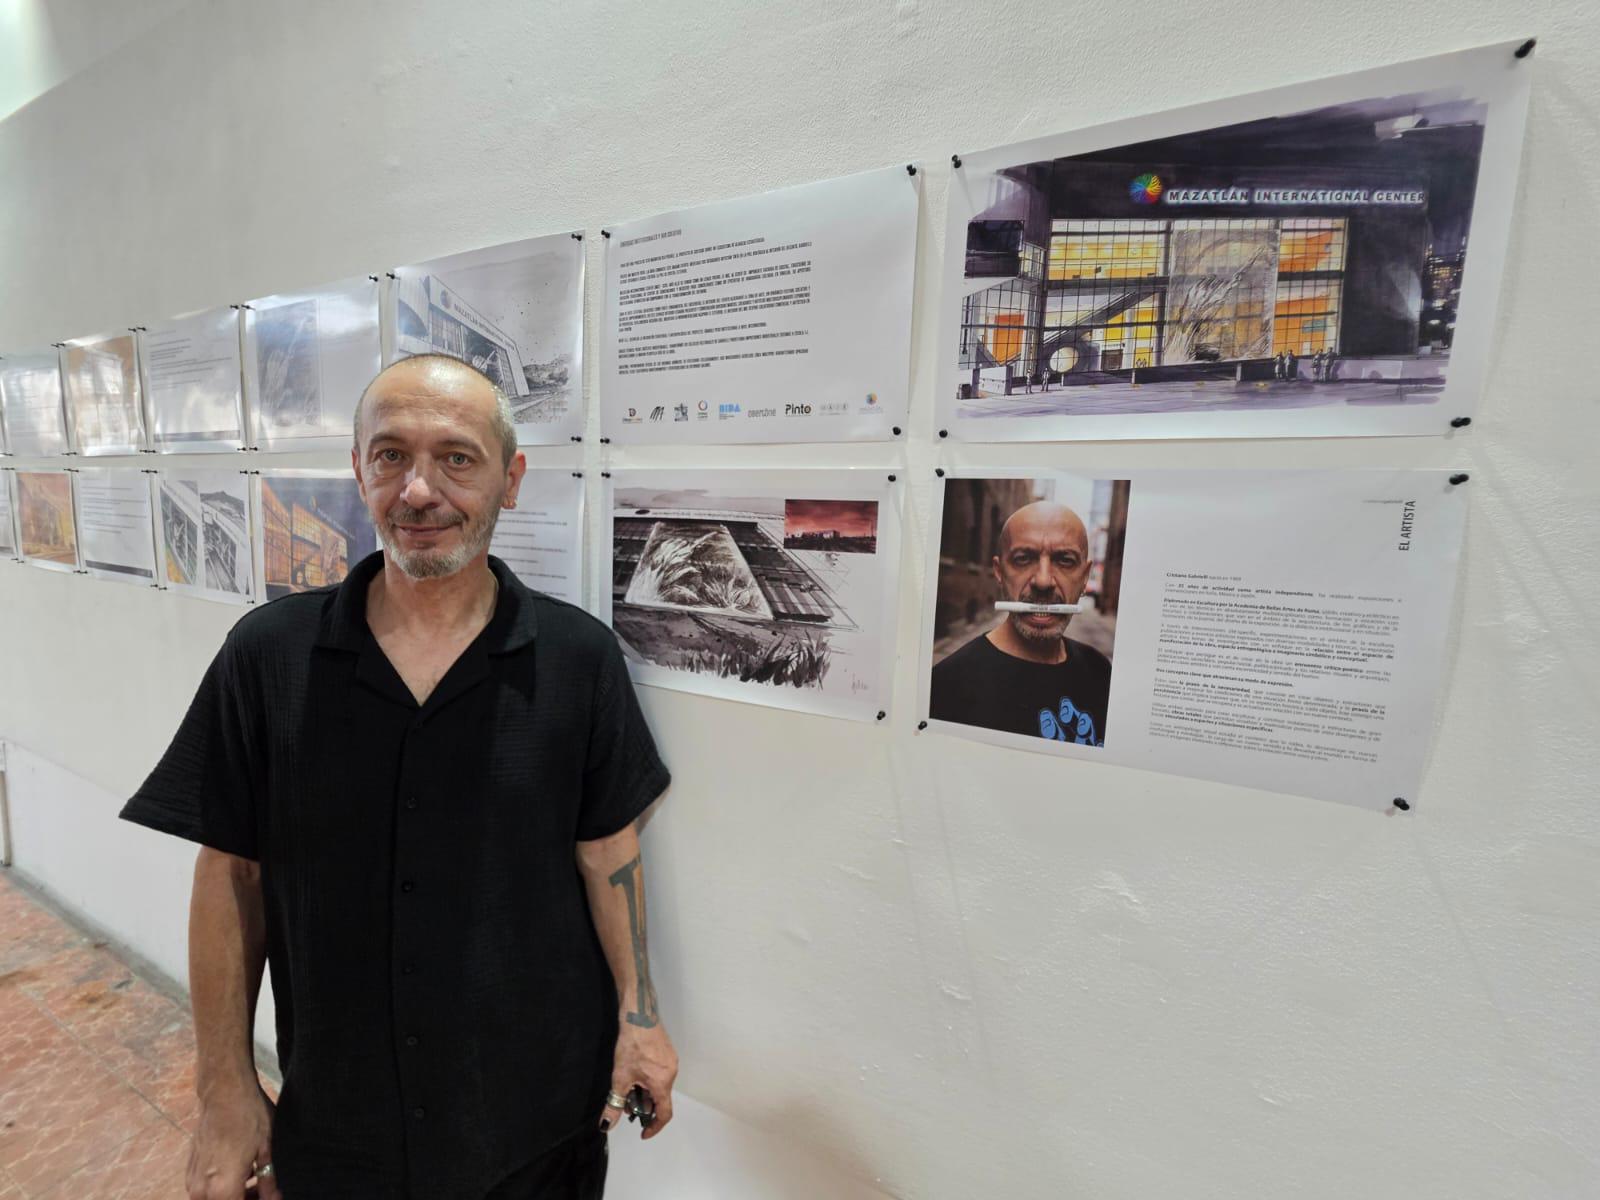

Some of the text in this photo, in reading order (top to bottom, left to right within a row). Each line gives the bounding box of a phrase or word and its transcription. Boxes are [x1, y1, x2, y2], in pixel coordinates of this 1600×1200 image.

[1254, 188, 1370, 203] INTERNATIONAL
[1374, 189, 1426, 203] CENTER
[785, 403, 812, 415] Pinto
[1398, 500, 1417, 551] EL ARTISTA
